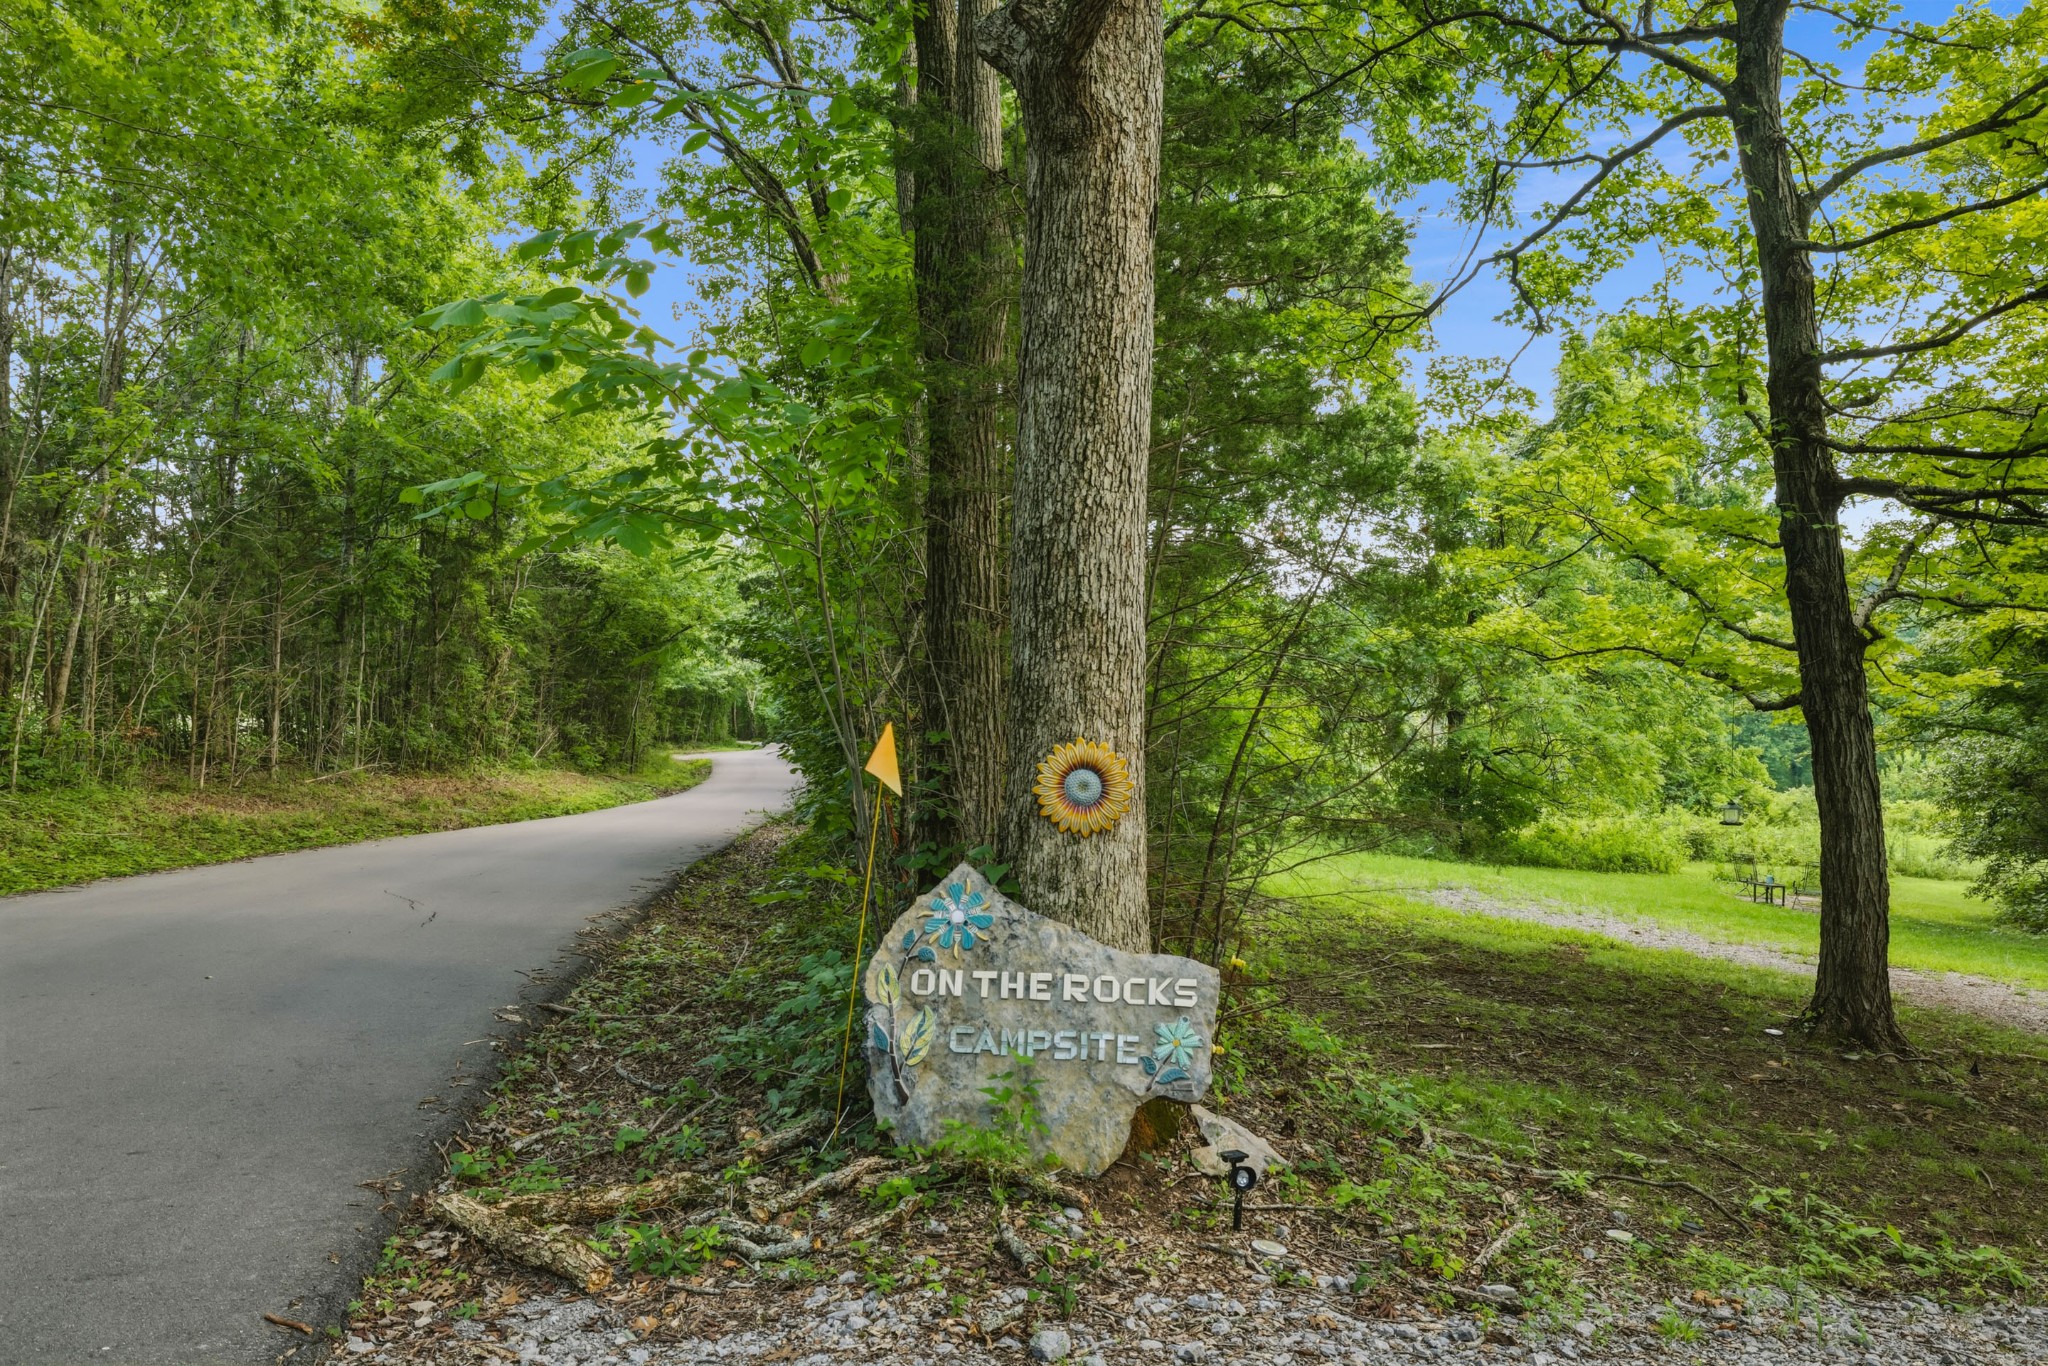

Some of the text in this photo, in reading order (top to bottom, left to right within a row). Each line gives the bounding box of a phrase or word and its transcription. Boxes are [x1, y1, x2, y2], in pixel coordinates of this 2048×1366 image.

[911, 969, 1198, 1008] ON THE ROCKS
[950, 1025, 1140, 1065] CAMPSITE
